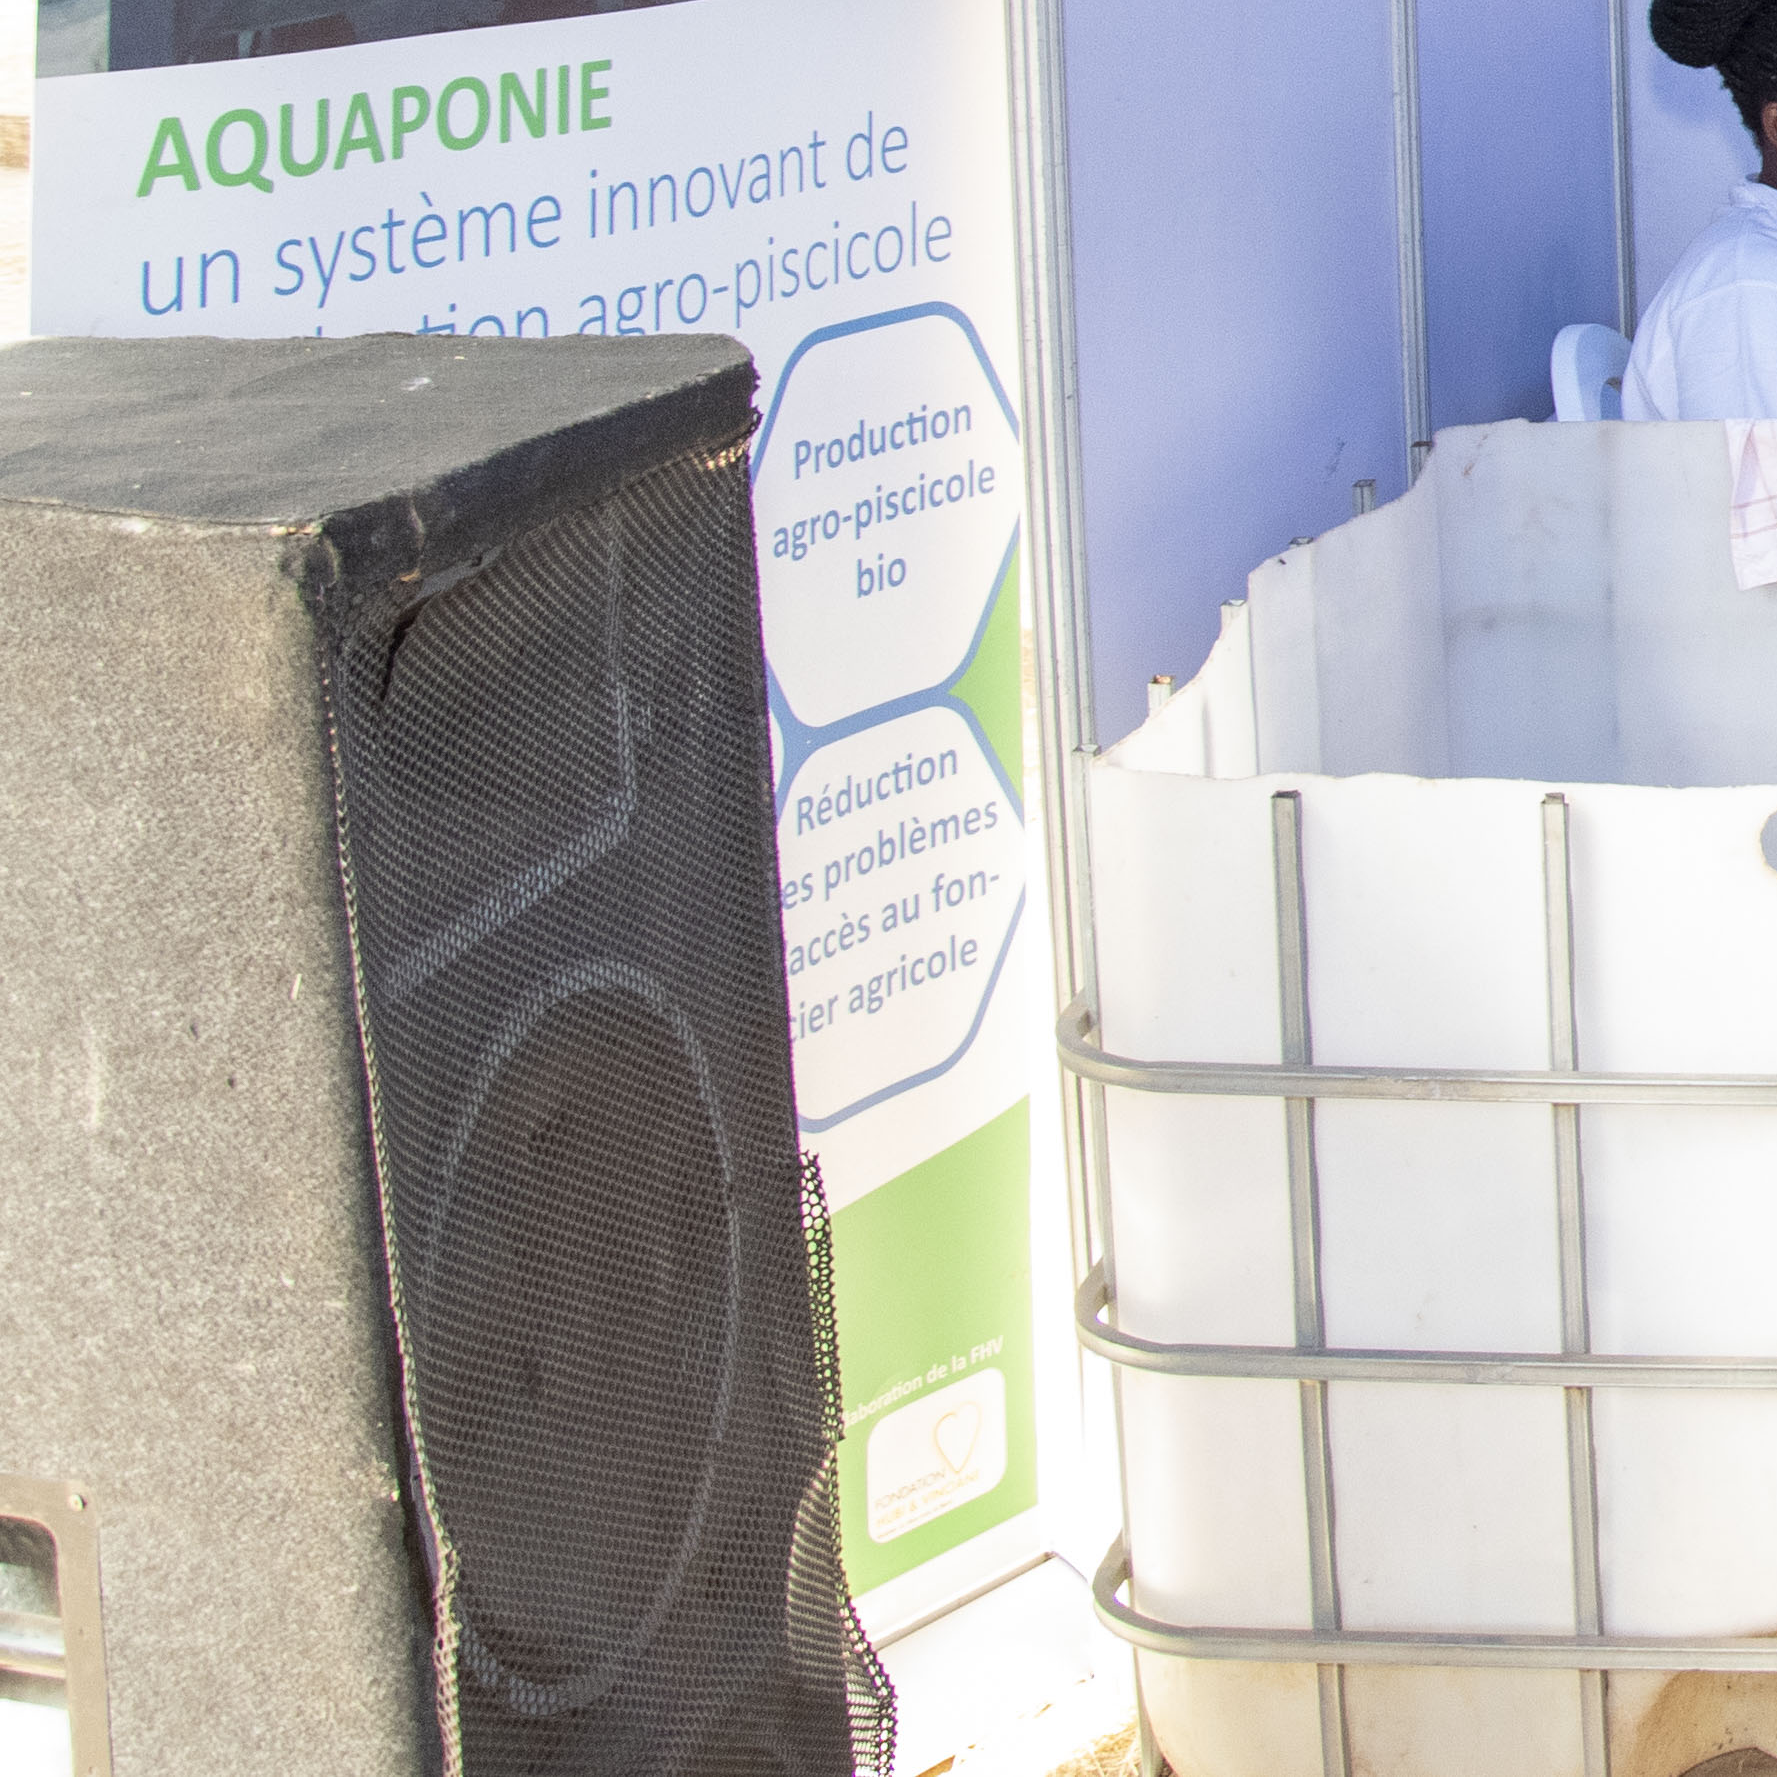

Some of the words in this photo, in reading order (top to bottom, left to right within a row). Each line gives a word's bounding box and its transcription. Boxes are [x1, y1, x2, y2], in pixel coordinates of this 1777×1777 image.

[136, 59, 613, 199] AQUAPONIE
[142, 246, 241, 317] un
[273, 190, 562, 310] système
[590, 130, 828, 238] innovant
[846, 109, 909, 182] de
[577, 199, 952, 337] agro-piscicole
[794, 403, 972, 481] Production
[773, 458, 996, 563] agro-piscicole
[856, 552, 907, 600] bio
[796, 748, 958, 837] Réduction
[781, 871, 815, 911] es
[824, 800, 999, 903] problèmes
[788, 911, 872, 976] accès
[880, 892, 921, 933] au
[931, 870, 1000, 913] fon-
[848, 933, 979, 1015] agricole
[925, 1363, 949, 1384] de
[951, 1354, 967, 1373] la
[969, 1334, 1005, 1365] FHV
